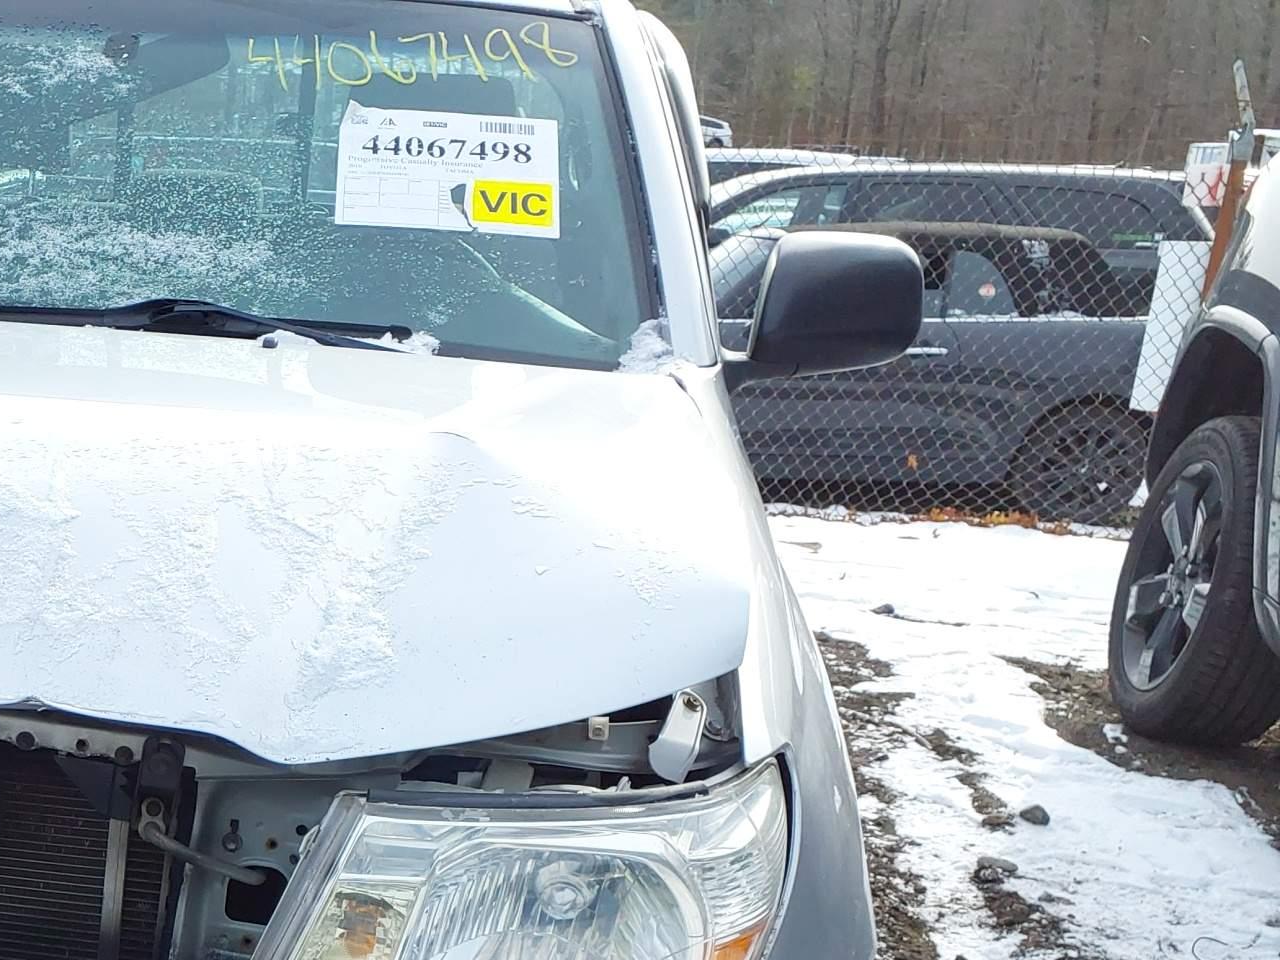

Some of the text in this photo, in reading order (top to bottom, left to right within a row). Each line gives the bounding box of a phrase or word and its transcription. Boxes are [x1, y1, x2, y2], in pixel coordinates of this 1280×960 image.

[248, 21, 578, 92] 44067498
[361, 134, 532, 164] 44067498
[441, 159, 484, 168] Insurance
[478, 189, 548, 217] VIC
